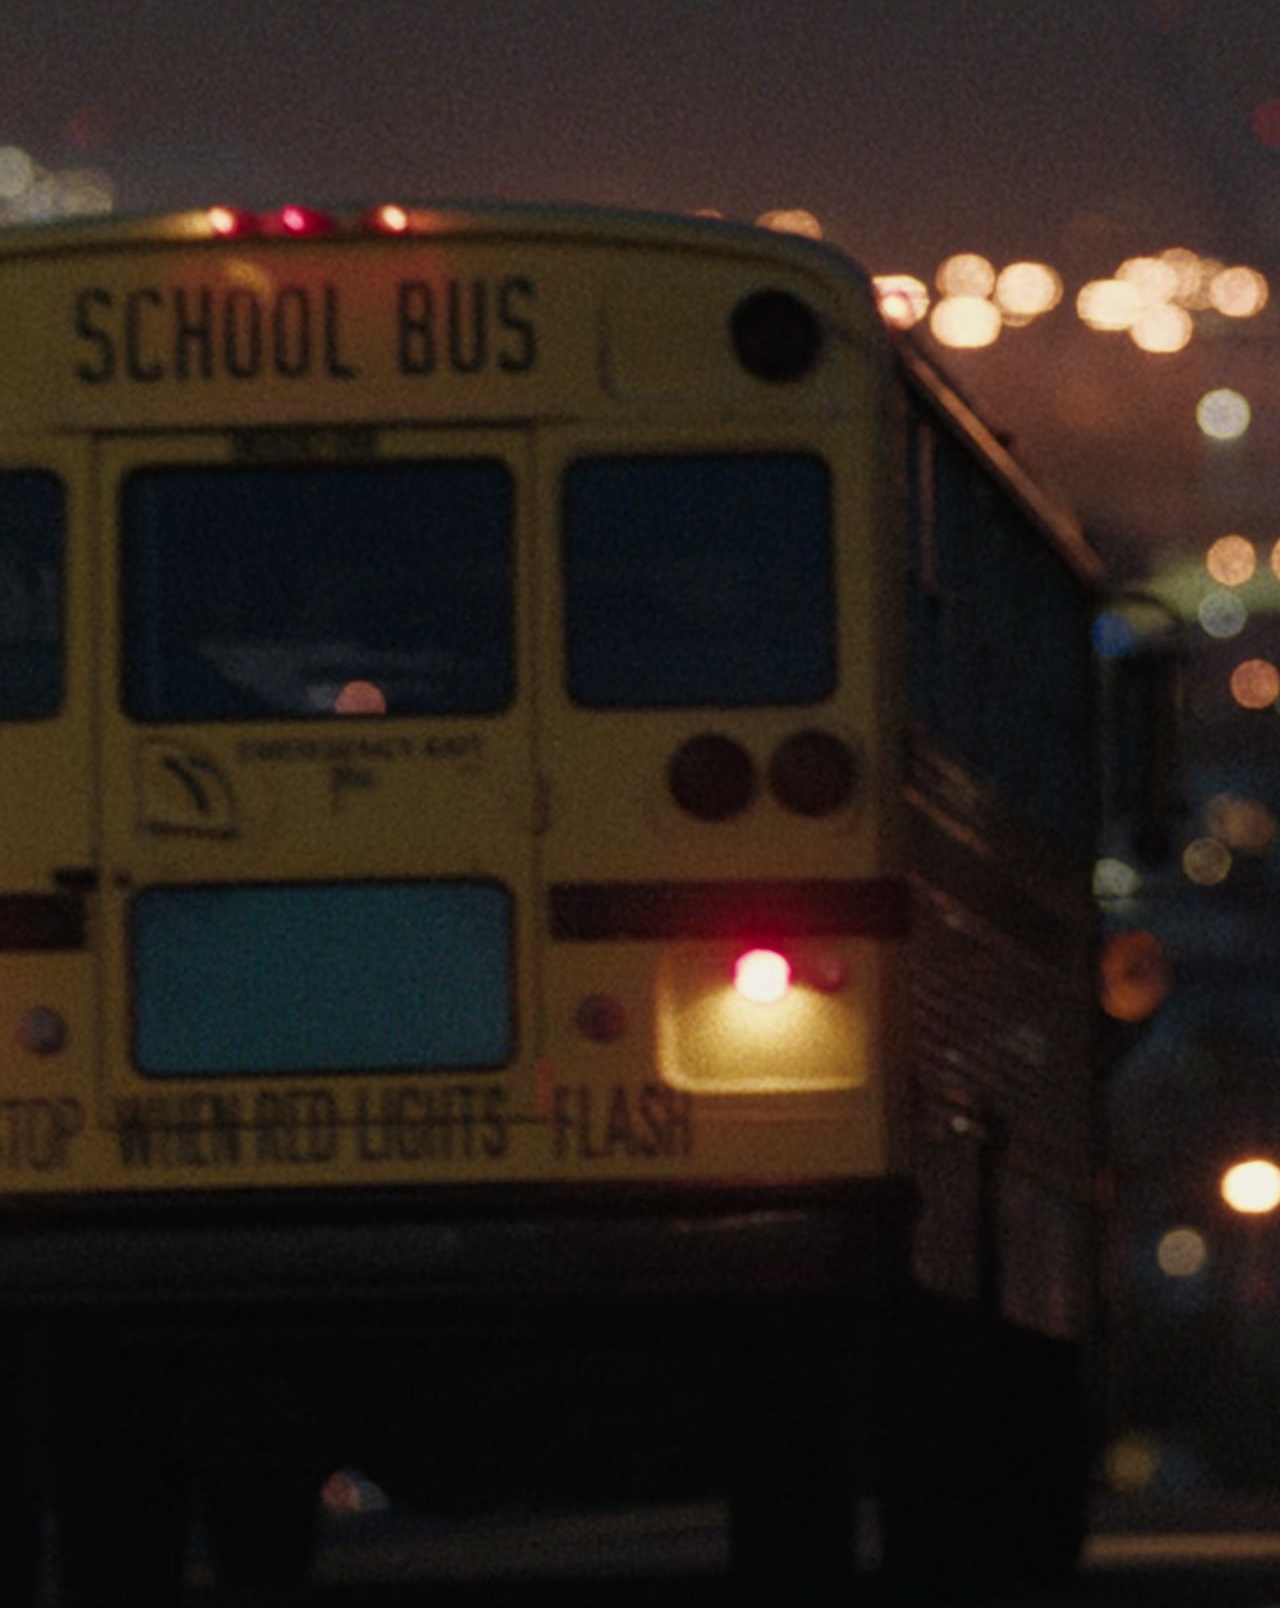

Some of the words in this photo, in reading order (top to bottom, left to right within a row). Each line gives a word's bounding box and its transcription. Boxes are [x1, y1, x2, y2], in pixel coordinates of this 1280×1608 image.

[74, 284, 358, 385] SCHOOL
[398, 275, 540, 377] BUS
[113, 1091, 241, 1168] WHEN
[256, 1088, 336, 1164] RED
[357, 1084, 509, 1164] LIGHTS
[554, 1083, 694, 1161] FLASH
